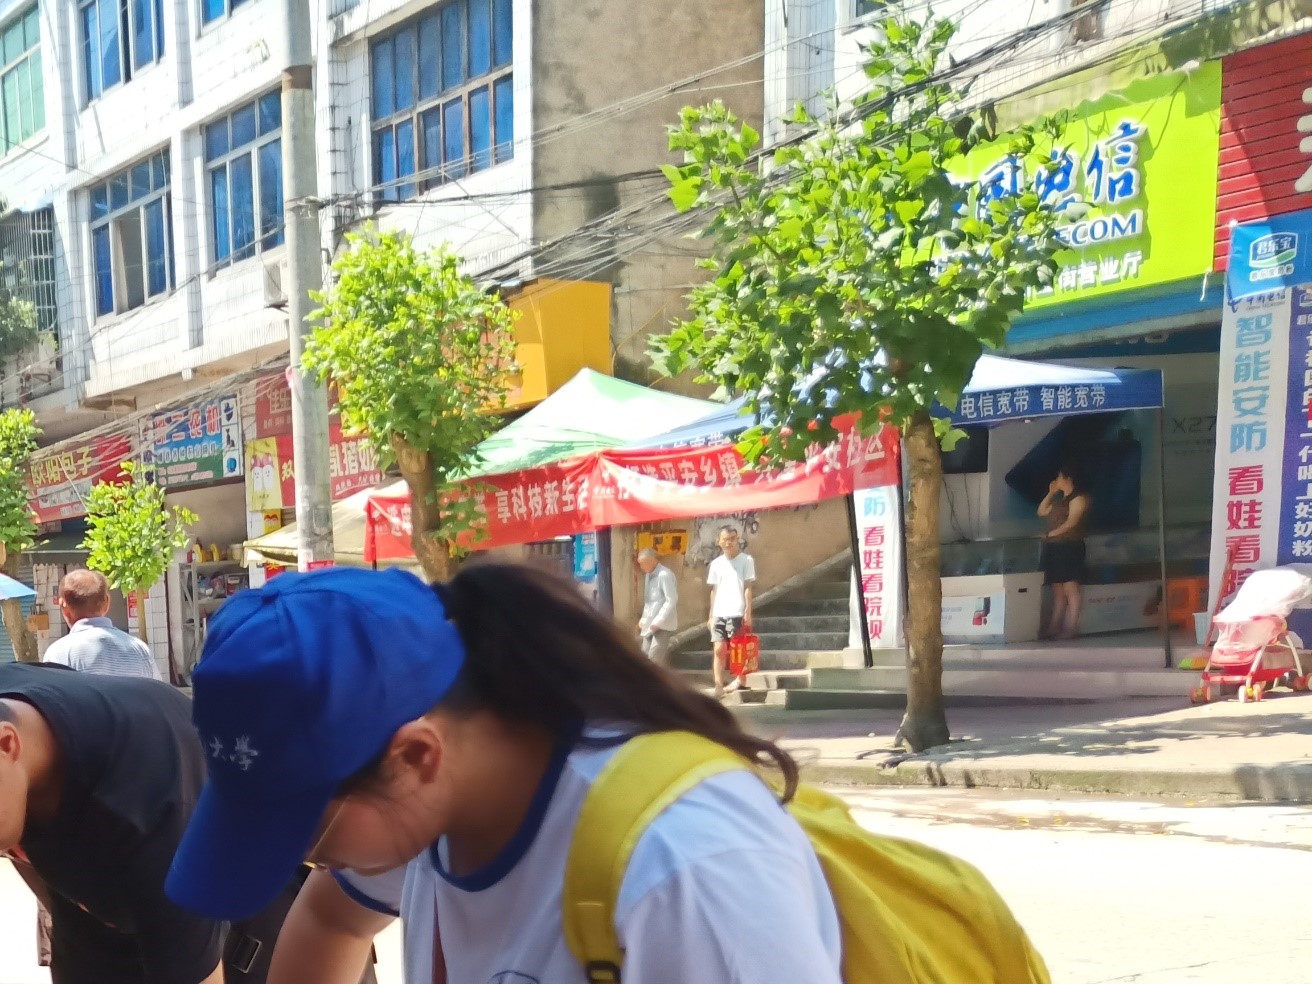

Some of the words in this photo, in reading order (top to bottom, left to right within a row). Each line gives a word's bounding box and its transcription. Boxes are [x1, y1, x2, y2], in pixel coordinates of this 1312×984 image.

[961, 387, 1030, 419] 电信宽带
[1040, 383, 1106, 412] 智能宽带
[1230, 313, 1273, 453] 智能安防
[30, 446, 92, 488] 欧阳包子
